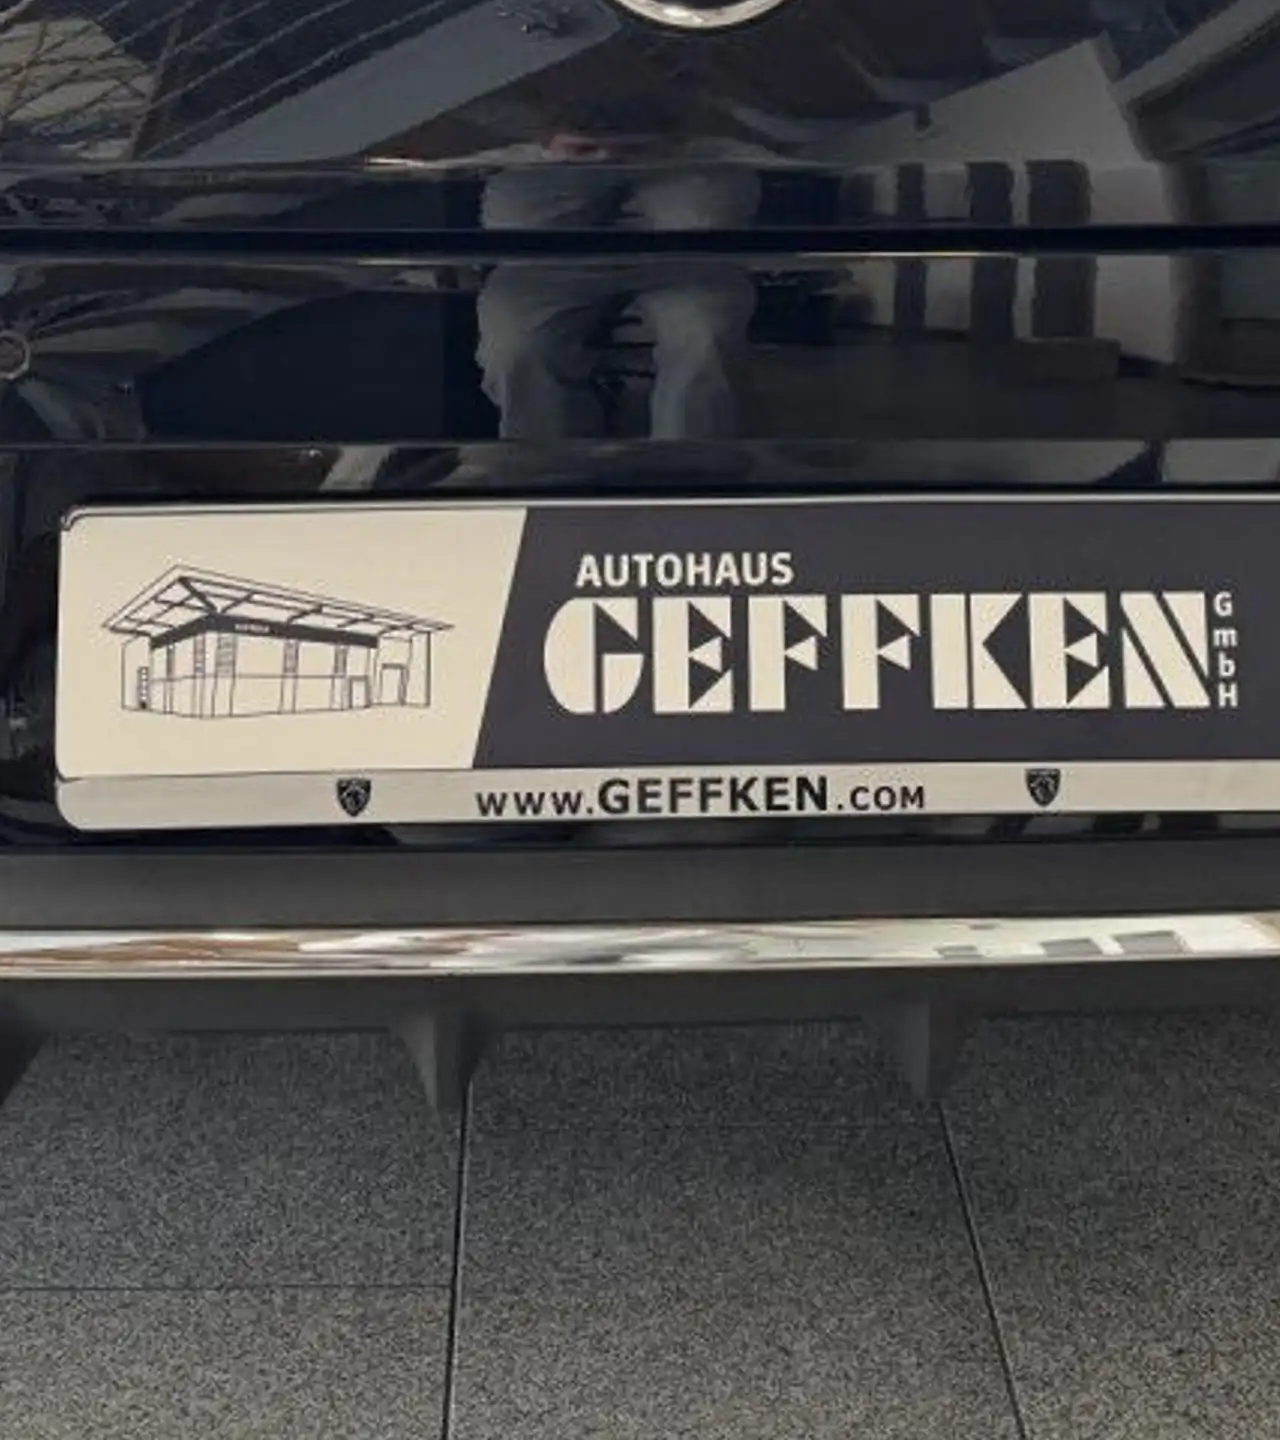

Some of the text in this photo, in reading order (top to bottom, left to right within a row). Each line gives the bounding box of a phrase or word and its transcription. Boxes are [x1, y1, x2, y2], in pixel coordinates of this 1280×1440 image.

[576, 551, 796, 588] AUTOHAUS
[543, 591, 1212, 715] GEFFKEN
[1213, 591, 1240, 708] GmbH
